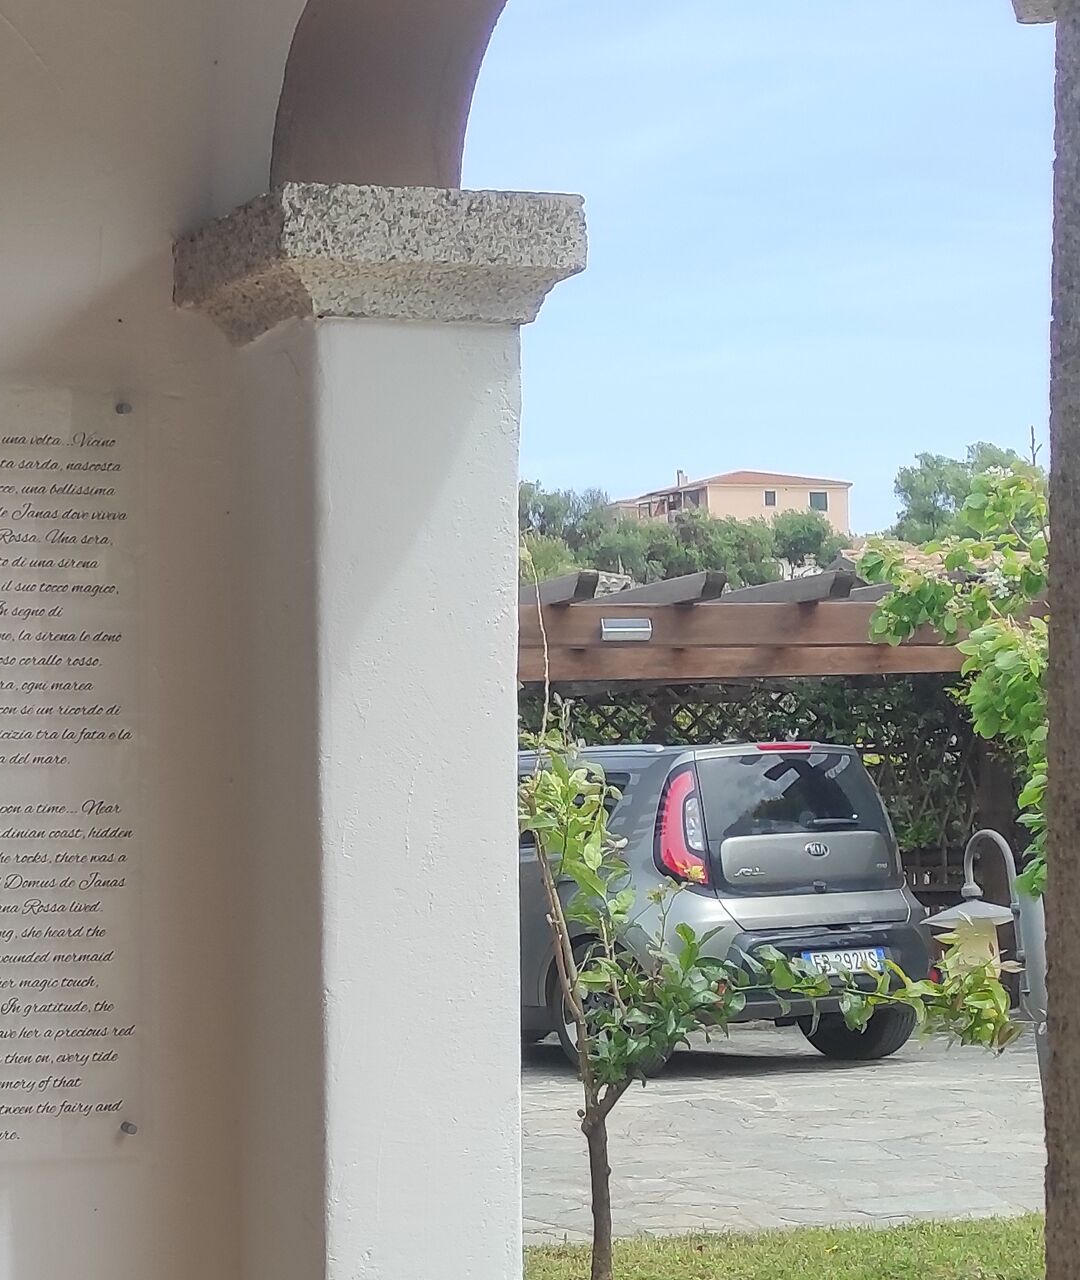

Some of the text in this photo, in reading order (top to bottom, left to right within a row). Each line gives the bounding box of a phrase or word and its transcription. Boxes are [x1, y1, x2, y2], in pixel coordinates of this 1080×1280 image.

[2, 436, 25, 444] una
[67, 462, 121, 471] nascosta
[21, 486, 46, 494] una
[50, 484, 115, 496] bellissima
[12, 503, 58, 520] Janas
[62, 509, 89, 519] dove
[45, 529, 76, 543] Una
[12, 556, 27, 567] di
[29, 560, 55, 568] una
[58, 559, 98, 568] sirena
[1, 581, 13, 591] il
[15, 583, 37, 592] suo
[39, 583, 69, 592] tocco
[12, 608, 45, 619] segno
[48, 606, 64, 617] di
[19, 631, 32, 640] la
[36, 633, 77, 641] sirena
[79, 631, 91, 641] le
[19, 655, 63, 666] corallo
[21, 681, 49, 694] ogni
[51, 681, 93, 691] marea
[36, 706, 54, 715] un
[58, 705, 104, 715] ricordo
[106, 705, 121, 715] di
[36, 730, 59, 740] tra
[62, 729, 74, 740] la
[74, 728, 106, 744] fata
[118, 729, 133, 740] la
[9, 753, 30, 764] del
[81, 800, 121, 816] Near
[87, 826, 133, 838] hidden
[55, 852, 87, 863] there
[89, 855, 115, 863] was
[118, 855, 128, 863] a
[4, 874, 57, 890] Domus
[59, 877, 75, 888] de
[79, 872, 125, 890] Janas
[22, 899, 66, 915] Rossa
[21, 927, 42, 938] she
[43, 926, 83, 938] heard
[86, 926, 106, 937] the
[52, 951, 114, 963] mermaid
[19, 980, 59, 992] magic
[1, 997, 21, 1015] In
[94, 1000, 114, 1012] the
[19, 1027, 41, 1039] her
[54, 1026, 108, 1041] precious
[113, 1024, 135, 1036] red
[5, 1052, 32, 1064] then
[56, 1053, 90, 1066] every
[92, 1051, 119, 1062] tide
[38, 1076, 52, 1092] of
[53, 1076, 82, 1087] that
[36, 1101, 56, 1114] the
[55, 1100, 92, 1118] fairy
[95, 1099, 123, 1112] and
